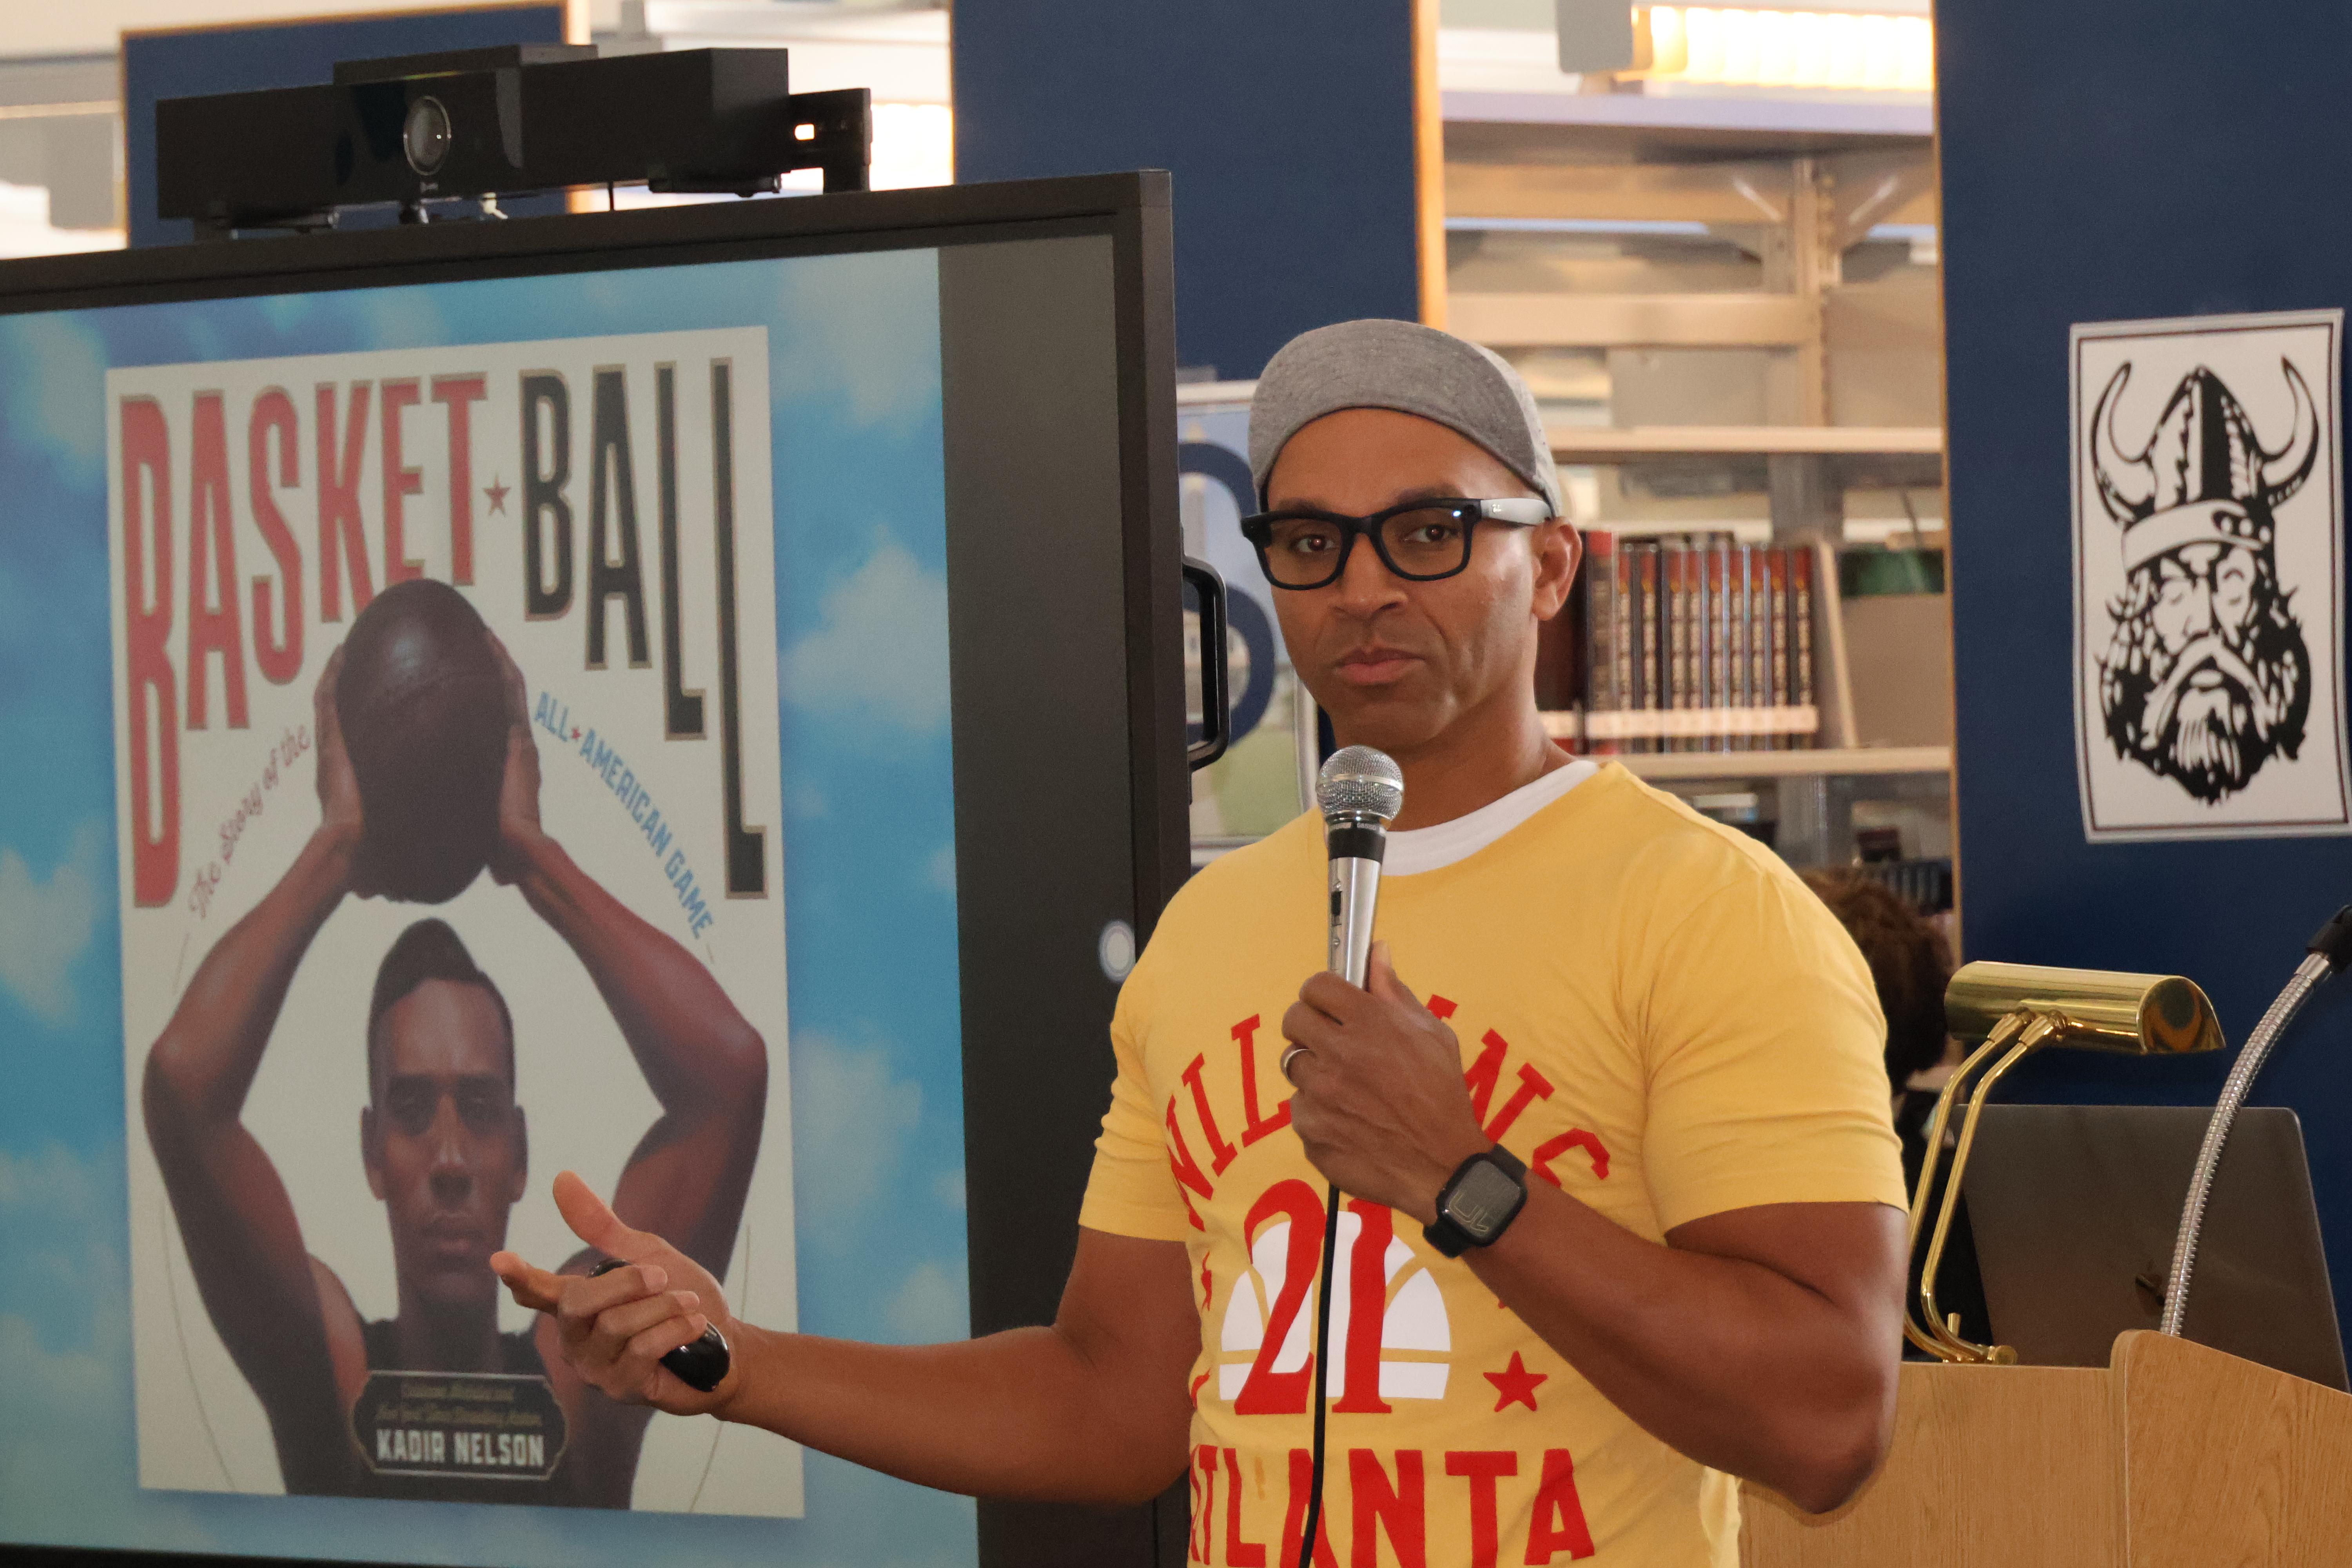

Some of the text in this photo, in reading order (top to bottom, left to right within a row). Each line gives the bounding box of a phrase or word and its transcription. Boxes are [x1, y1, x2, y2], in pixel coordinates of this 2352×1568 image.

[120, 371, 488, 908] BASKET
[519, 357, 768, 900] BALL
[188, 725, 310, 919] The Story of the
[534, 691, 713, 939] ALL AMERICAN GAME
[1233, 1178, 1393, 1415] 21
[376, 1428, 545, 1466] KADIR NELSON
